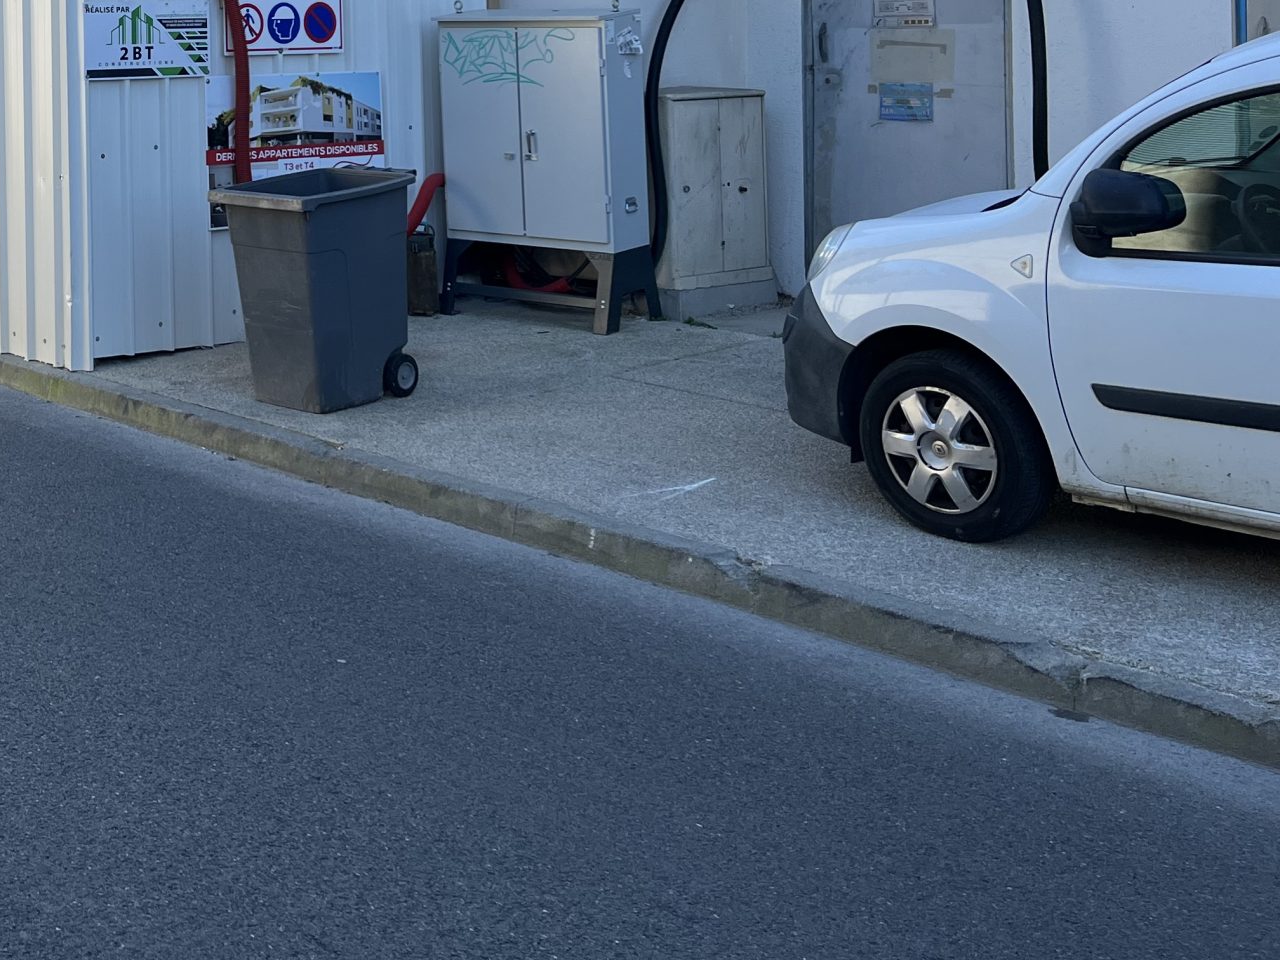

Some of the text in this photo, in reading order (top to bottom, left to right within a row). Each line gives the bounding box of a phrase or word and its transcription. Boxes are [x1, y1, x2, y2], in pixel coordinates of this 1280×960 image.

[85, 5, 115, 13] RÉALISÉ
[258, 146, 326, 159] APPARTEMENTS
[326, 143, 378, 155] DISPONIBLES
[283, 163, 294, 171] T3
